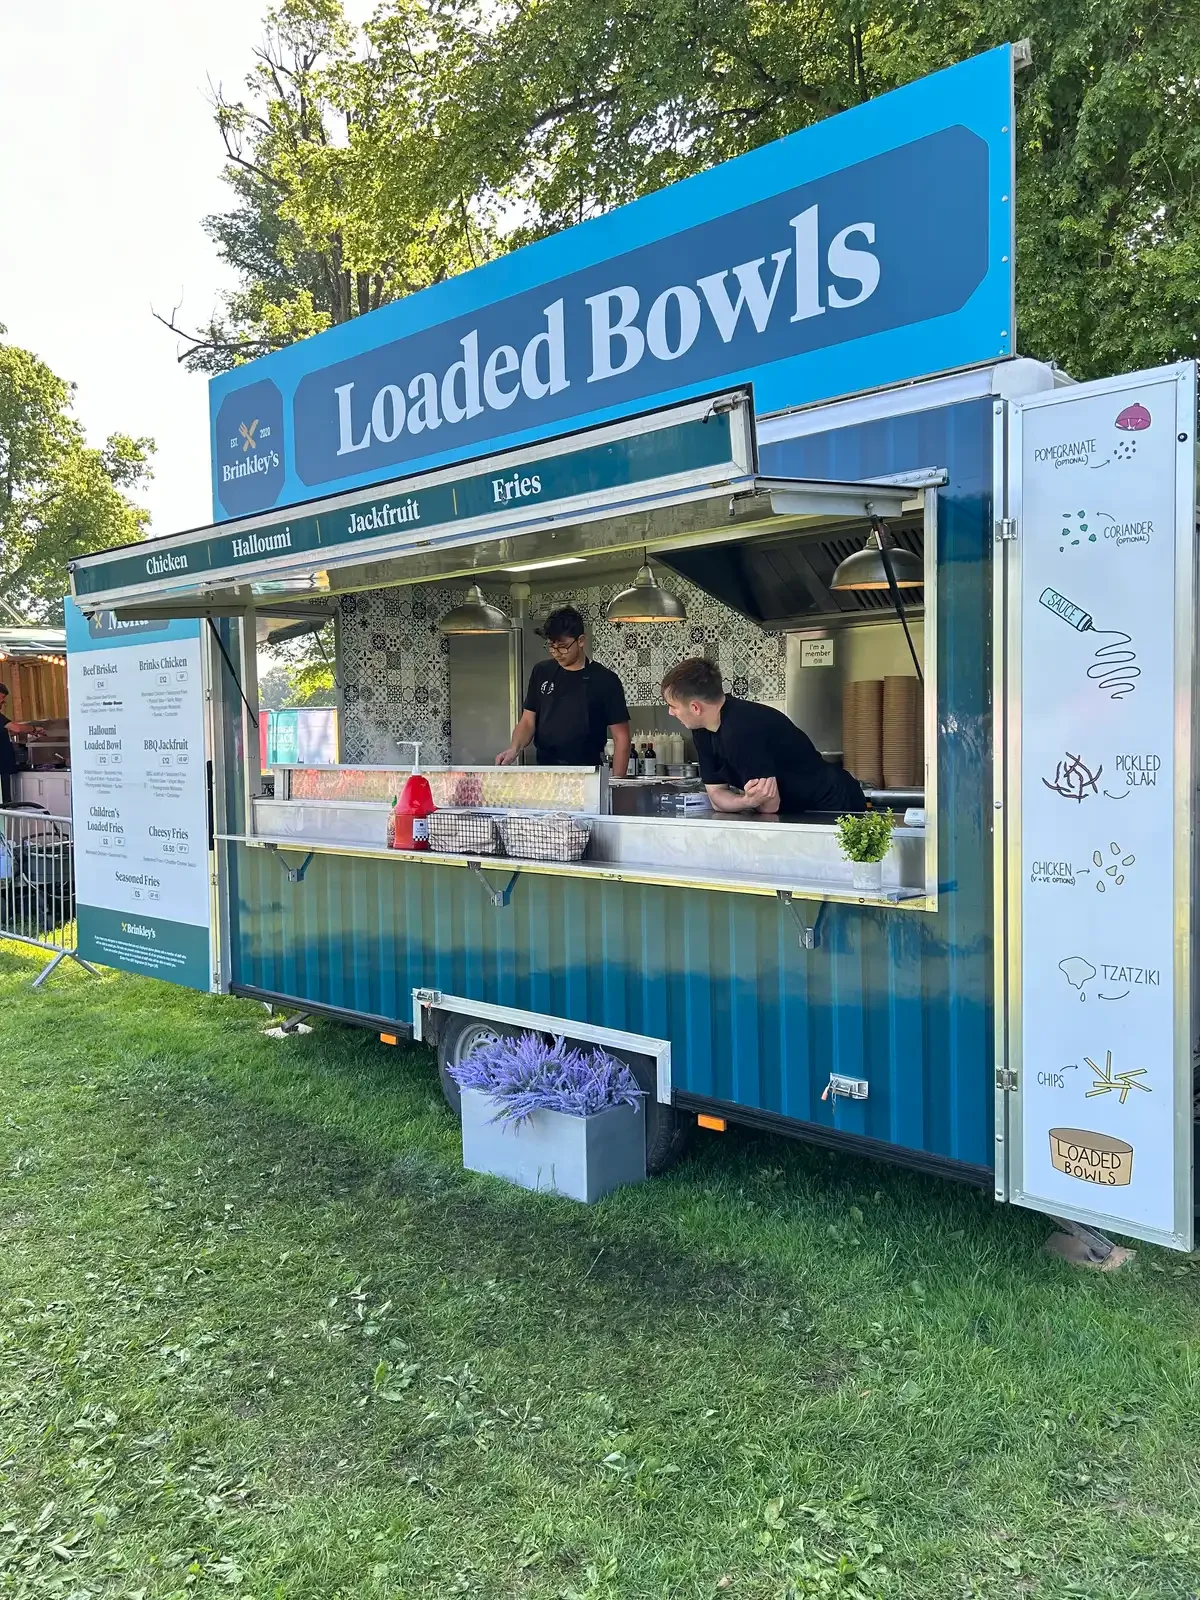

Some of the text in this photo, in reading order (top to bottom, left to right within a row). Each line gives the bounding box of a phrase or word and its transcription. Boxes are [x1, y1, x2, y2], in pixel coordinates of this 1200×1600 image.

[335, 204, 881, 456] Loaded Bowls
[259, 426, 271, 439] 2020
[1034, 438, 1096, 462] POMEGRANATE
[222, 450, 279, 482] Brinkley's
[1055, 454, 1089, 469] (OPTIONAL)
[492, 473, 542, 503] Fries
[348, 498, 421, 534] Jackfruit
[1104, 521, 1154, 539] CORIANDER
[232, 527, 292, 558] Halloumi
[1116, 534, 1150, 547] (OPTIONAL)
[146, 553, 188, 575] Chicken
[1047, 593, 1079, 621] SAUCE
[83, 663, 118, 676] Beef Brisket
[139, 656, 188, 671] Brinks Chicken
[88, 725, 117, 736] Halloumi
[84, 739, 122, 751] Loaded Bowl
[144, 738, 189, 753] BBQ Jackfruit
[1116, 755, 1161, 772] PICKLED
[1126, 771, 1157, 786] SLAW
[89, 806, 120, 818] Children's
[87, 820, 124, 834] Loaded Fries
[148, 824, 189, 841] Cheesy Fries
[1032, 861, 1072, 876] CHICKEN
[115, 871, 161, 888] Seasoned Fries
[1051, 876, 1076, 887] OPTIONS)
[127, 923, 156, 939] Brinkley's
[1100, 963, 1161, 986] TZATZIKI
[1036, 1071, 1065, 1089] CHIPS
[1056, 1138, 1122, 1170] LOADED
[1064, 1161, 1117, 1185] BOWLS
